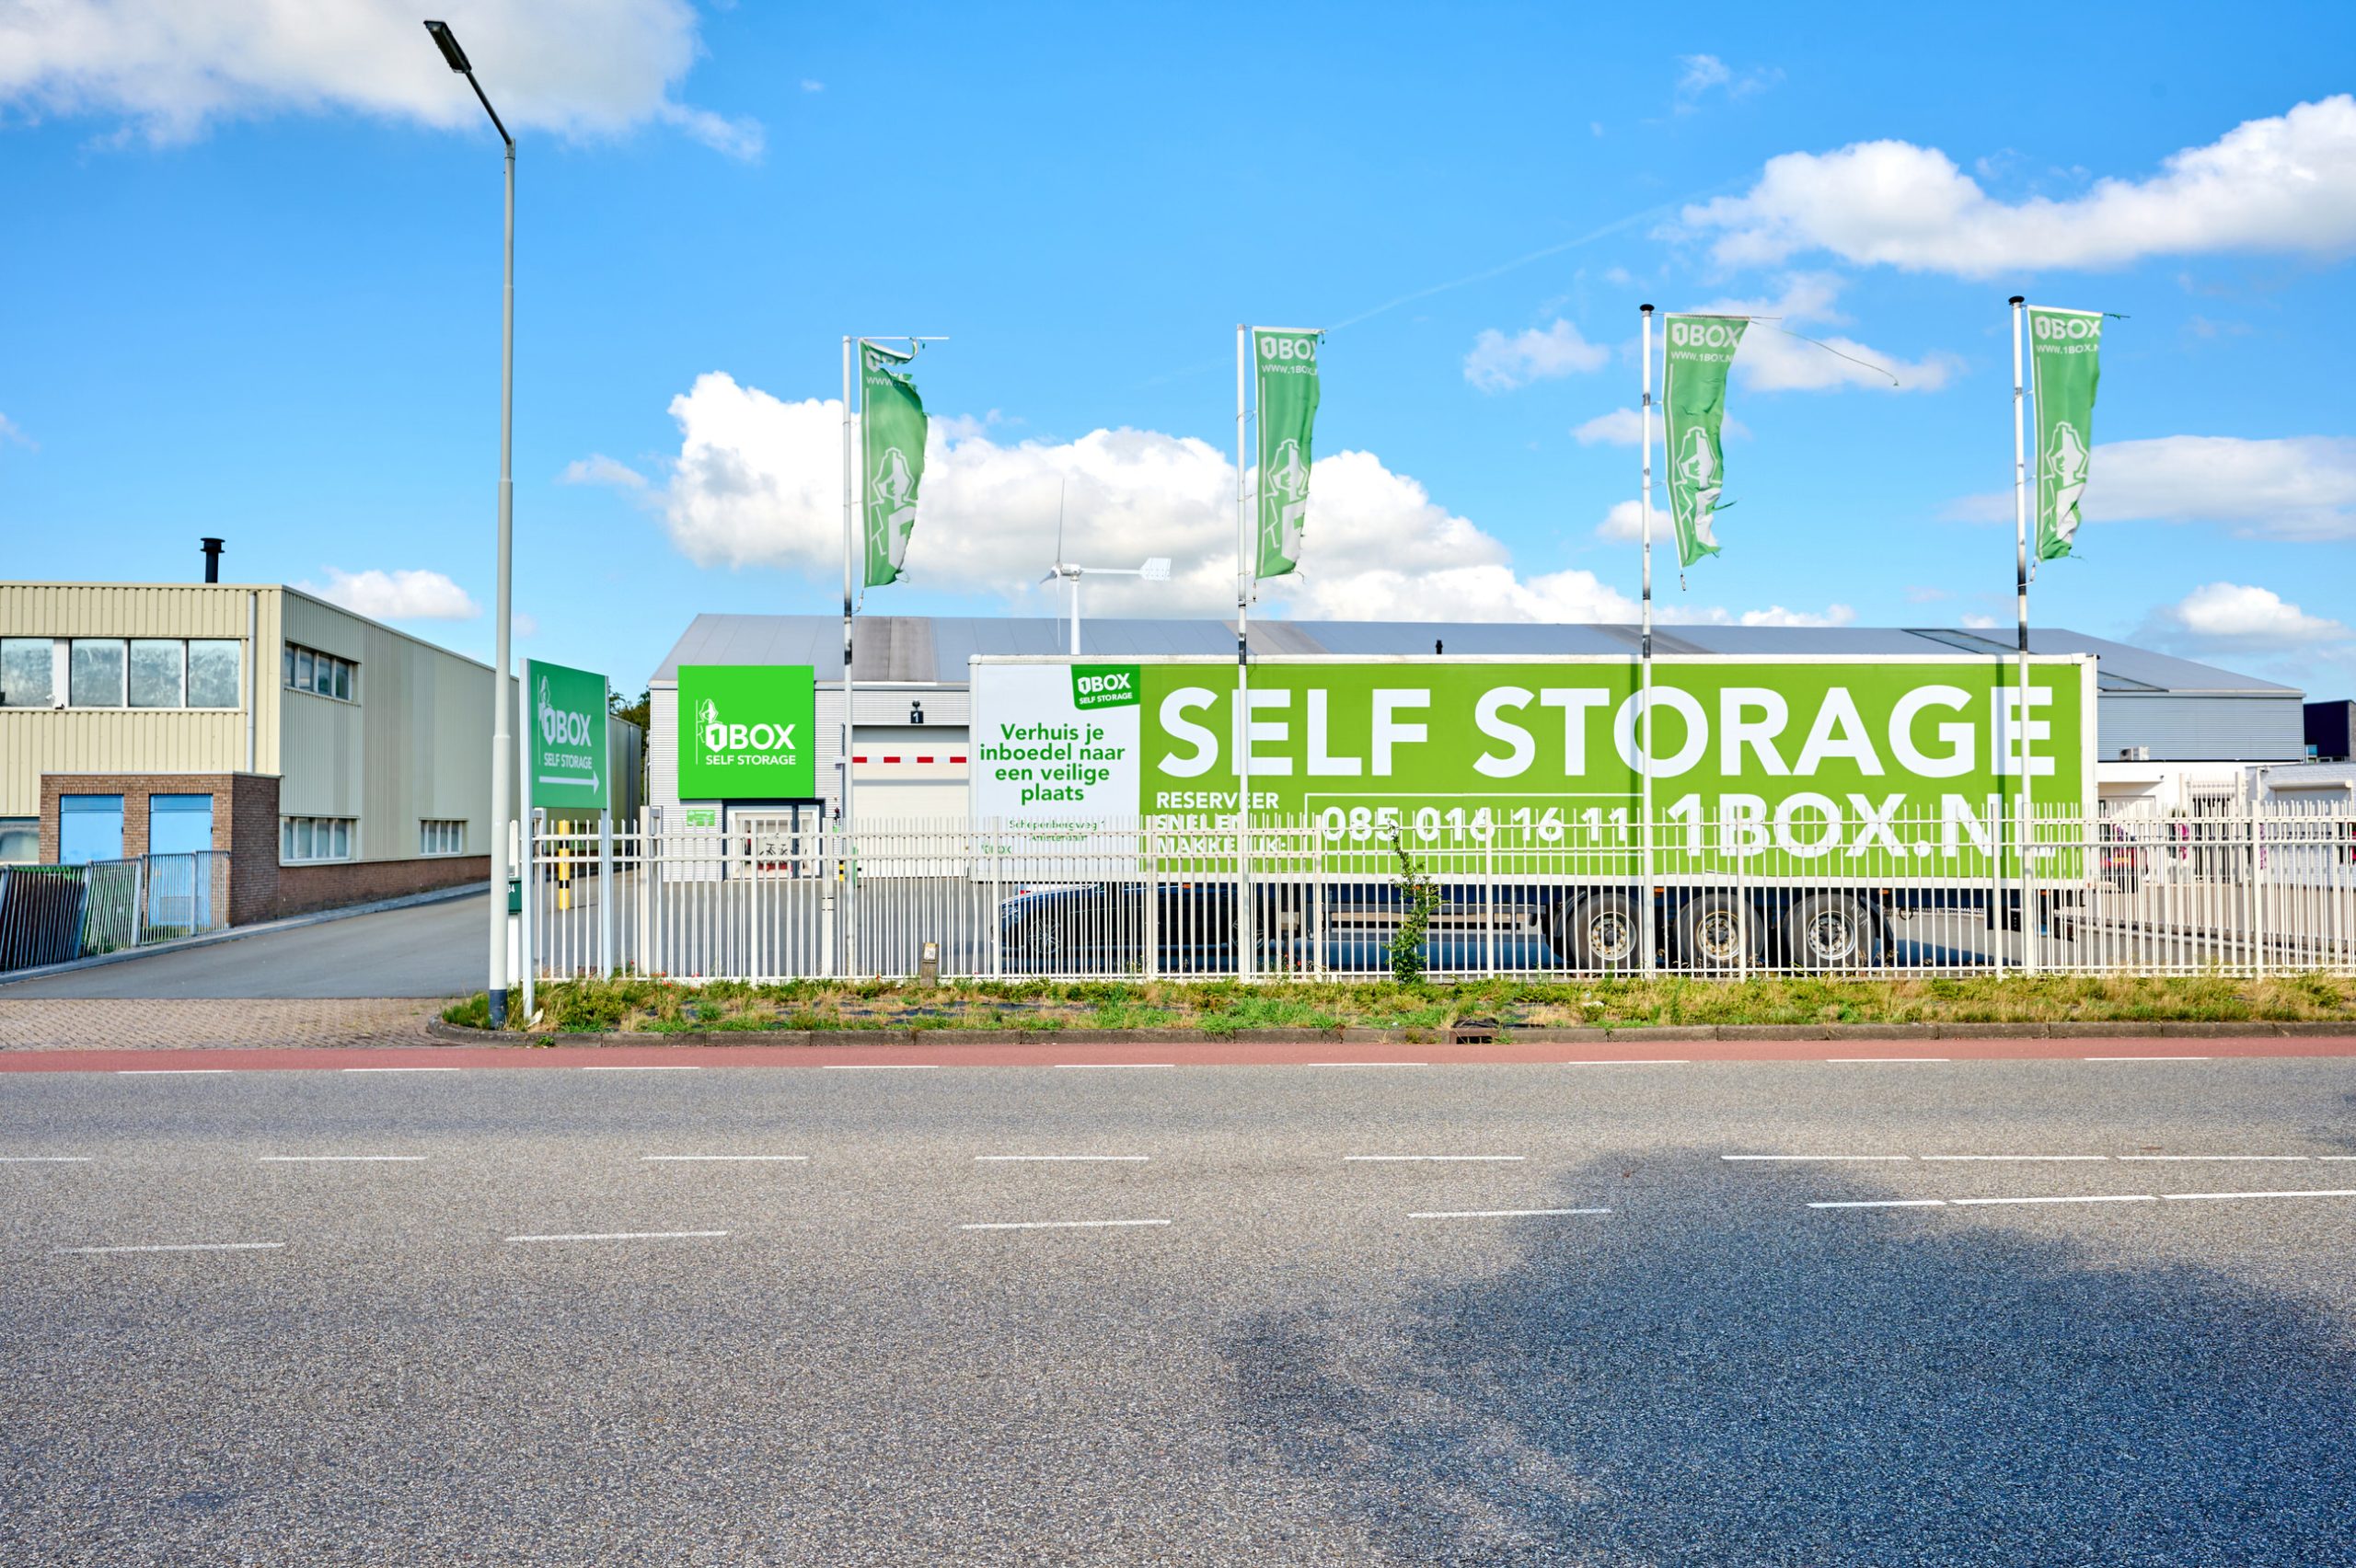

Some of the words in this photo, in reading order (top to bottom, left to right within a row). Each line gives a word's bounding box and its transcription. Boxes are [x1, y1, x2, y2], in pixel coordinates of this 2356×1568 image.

[1671, 322, 1743, 348] 1BOX
[2035, 315, 2102, 340] 1BOX
[1077, 673, 1131, 696] 1BOX
[1079, 696, 1096, 705] SELF
[1097, 692, 1134, 703] STORAGE
[543, 707, 593, 747] 1BOX
[913, 711, 919, 723] 1
[706, 722, 796, 754] 1BOX
[1000, 722, 1080, 741] Verhuis
[1084, 722, 1104, 745] je
[1156, 686, 1431, 778] SELF
[1472, 685, 2056, 778] STORAGE
[544, 752, 560, 767] SELF
[561, 754, 593, 769] STORAGE
[706, 755, 734, 766] SELF
[737, 755, 797, 766] STORAGE
[980, 743, 1072, 761] inboedel
[1080, 747, 1126, 761] naar
[995, 767, 1034, 781] een
[1041, 762, 1111, 786] veilige
[1022, 783, 1085, 806] plaats
[1321, 806, 1400, 842] 085
[1415, 806, 1496, 842] 016
[1512, 806, 1565, 842] 16
[1580, 806, 1628, 842] 11
